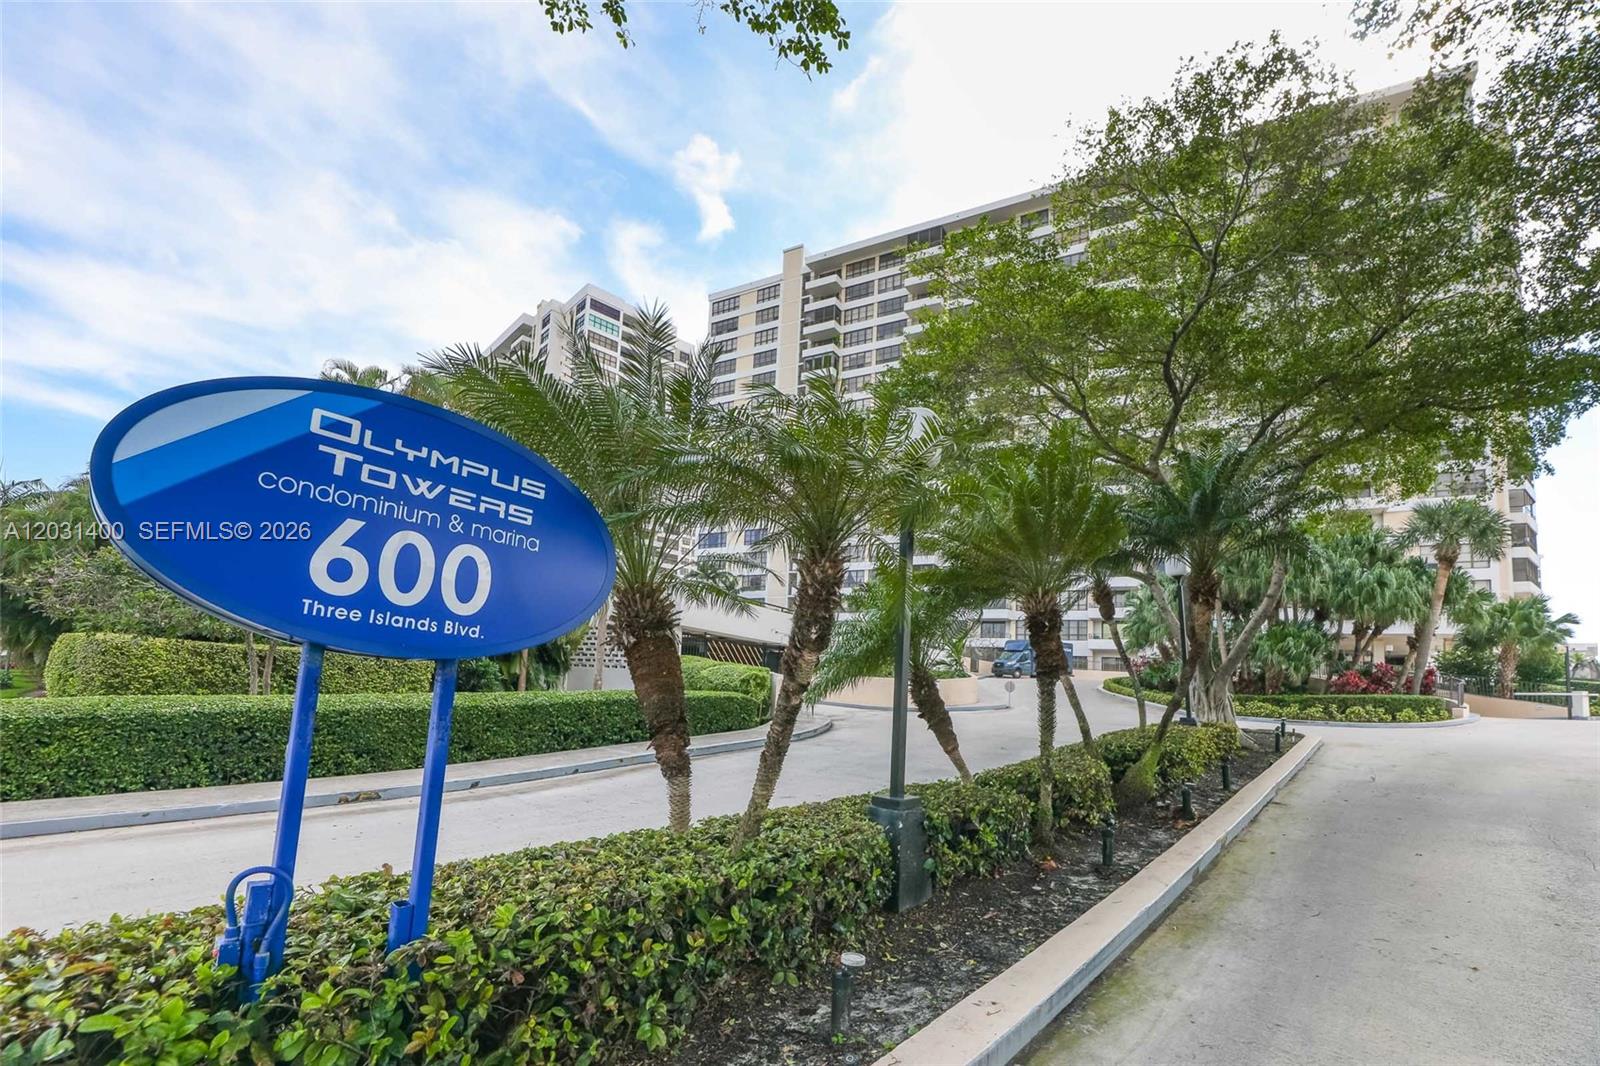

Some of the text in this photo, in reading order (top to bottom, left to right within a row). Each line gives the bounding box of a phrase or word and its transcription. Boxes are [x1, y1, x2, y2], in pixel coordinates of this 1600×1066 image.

[309, 408, 546, 500] OLYMPUS
[318, 444, 534, 526] TOWERS
[258, 471, 540, 552] condominium & marina
[309, 518, 492, 617] 600
[302, 598, 485, 639] Three Islands Blvd.
